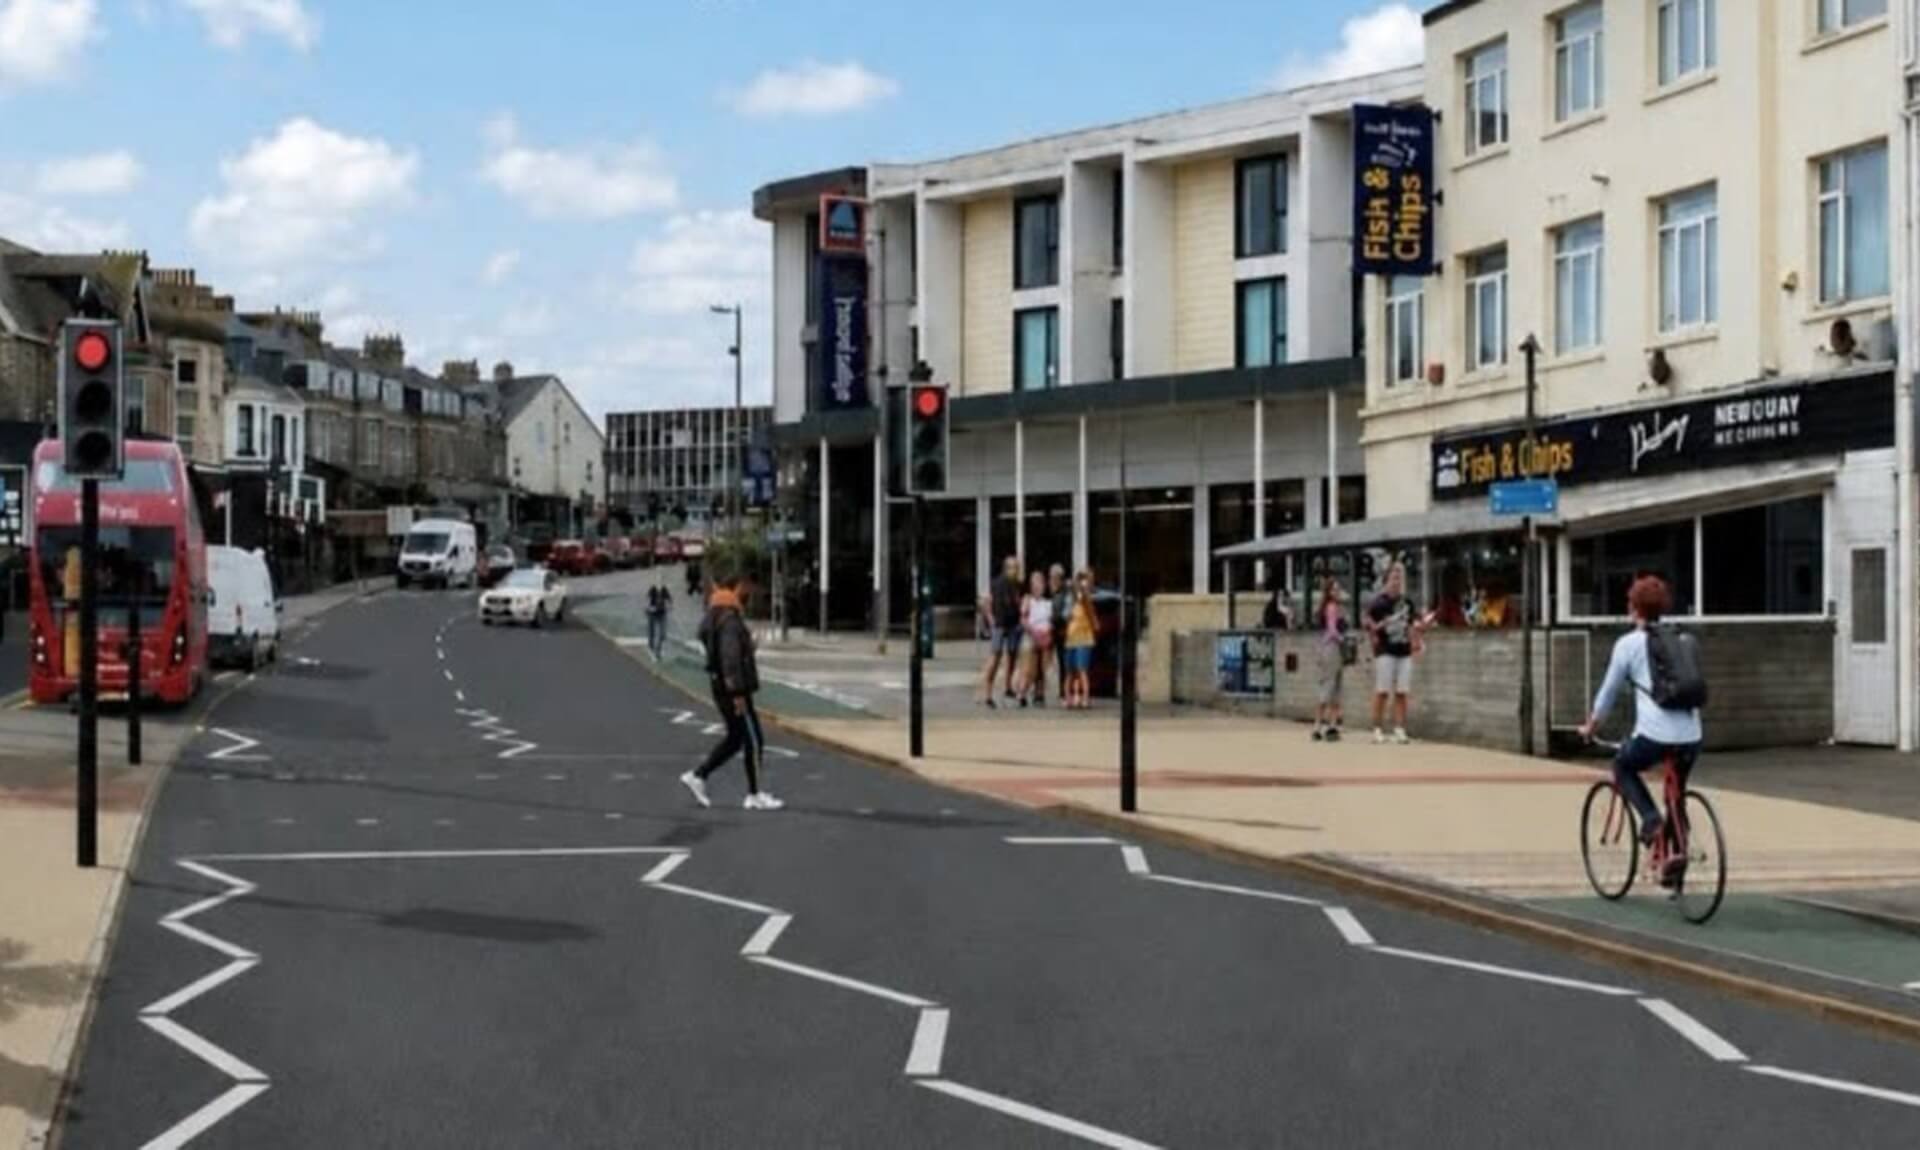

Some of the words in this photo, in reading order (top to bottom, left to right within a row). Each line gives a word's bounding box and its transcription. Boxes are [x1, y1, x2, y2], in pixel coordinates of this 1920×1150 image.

[1362, 167, 1391, 191] &
[1362, 197, 1390, 260] Fish
[1393, 173, 1428, 262] Chips
[1714, 394, 1800, 427] NEWQUAY
[1460, 442, 1496, 484] Fish
[1501, 442, 1515, 478] &
[1518, 434, 1574, 478] Chips
